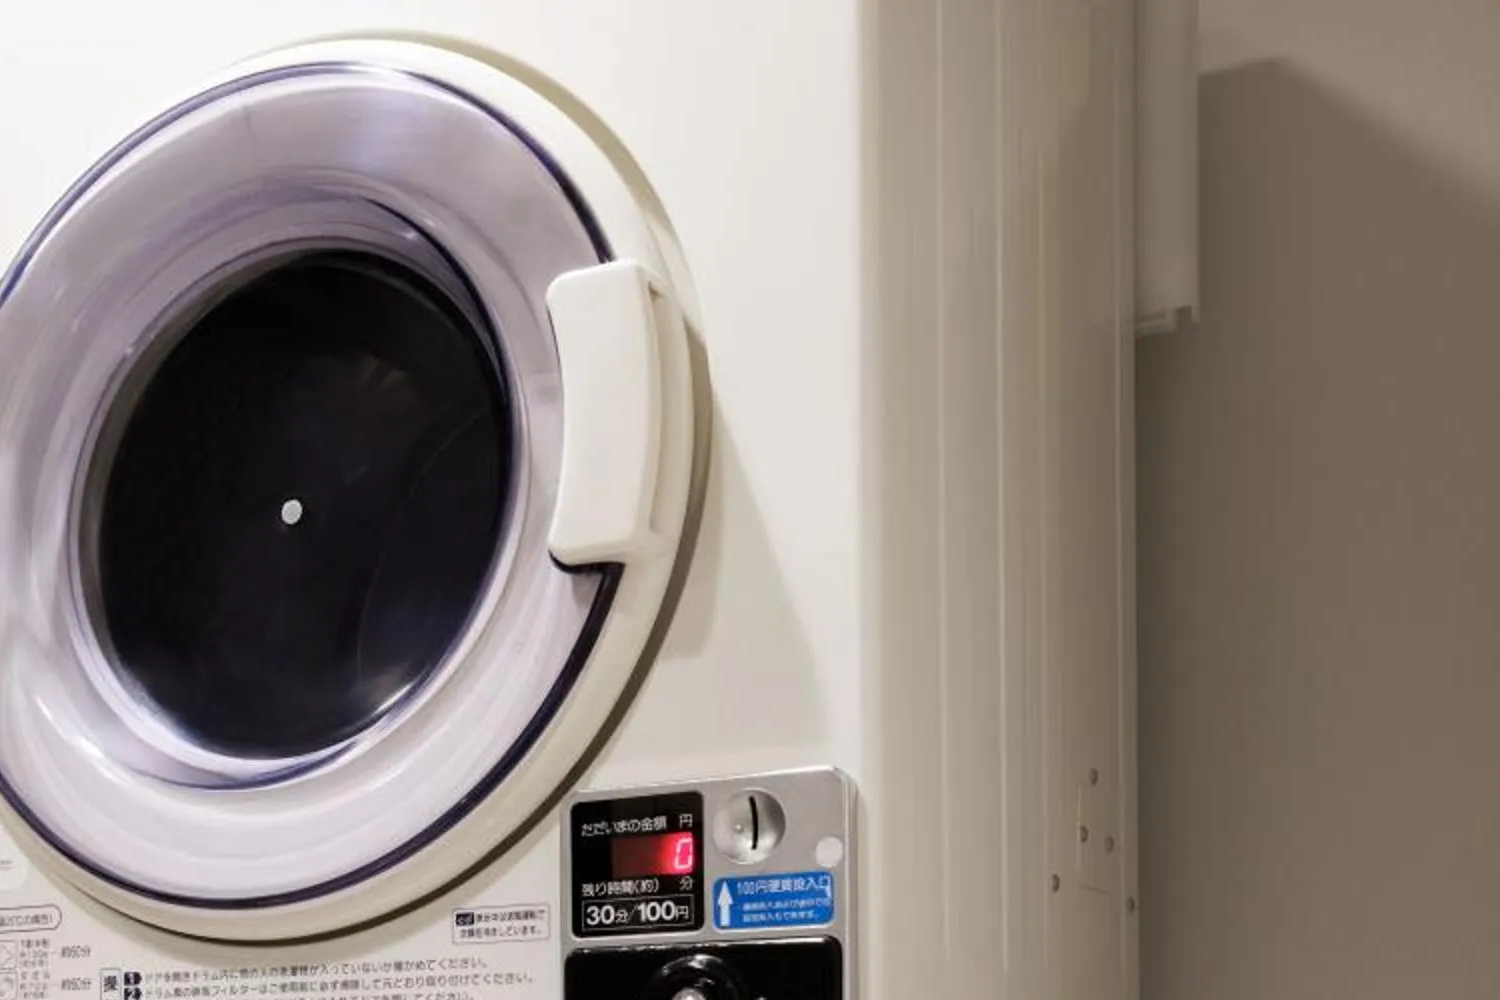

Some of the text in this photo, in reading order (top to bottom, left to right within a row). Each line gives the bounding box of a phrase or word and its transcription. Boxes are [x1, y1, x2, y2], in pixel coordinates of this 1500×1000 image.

[679, 814, 693, 828] 円
[674, 837, 694, 870] 0
[679, 877, 694, 891] 分
